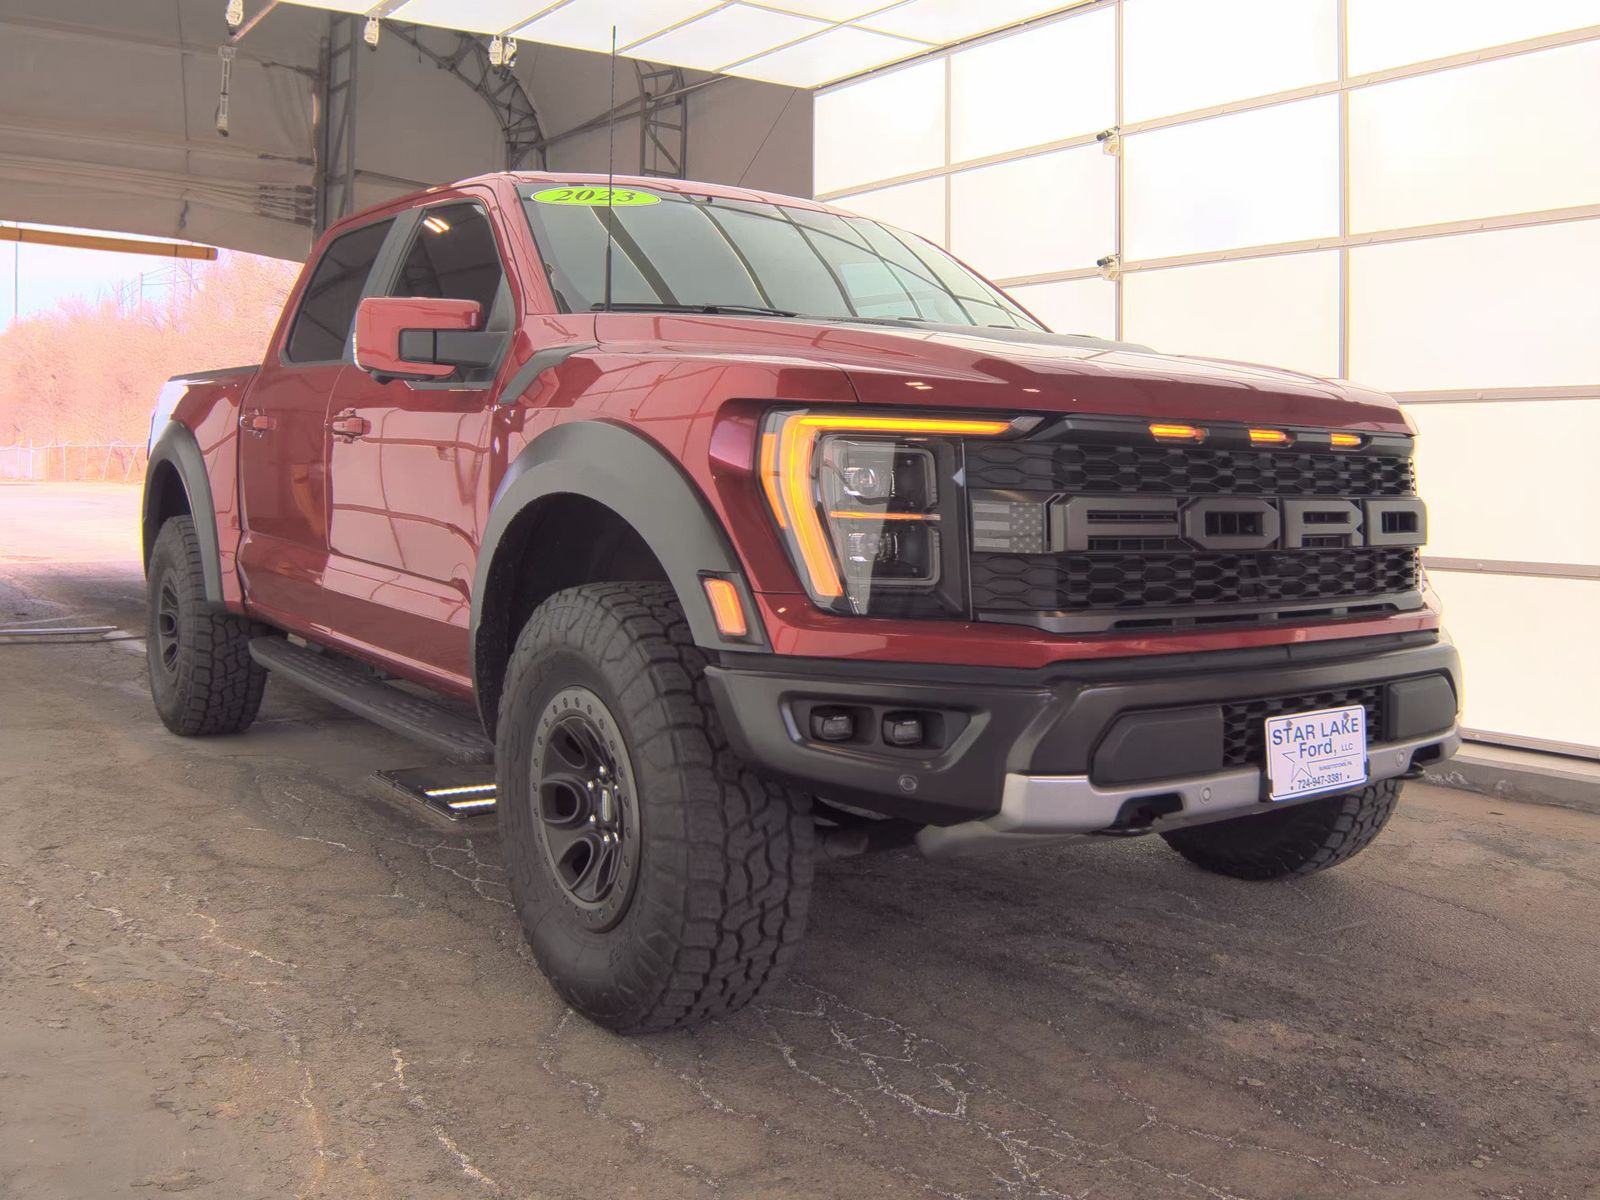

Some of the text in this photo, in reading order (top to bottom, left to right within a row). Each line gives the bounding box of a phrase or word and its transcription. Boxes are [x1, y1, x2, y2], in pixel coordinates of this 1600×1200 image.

[554, 190, 636, 202] 2023
[1051, 492, 1427, 551] FORD
[1273, 717, 1359, 746] STAR LAKE
[1299, 738, 1353, 759] Ford, LLC
[1297, 772, 1343, 790] 724-947-3381
